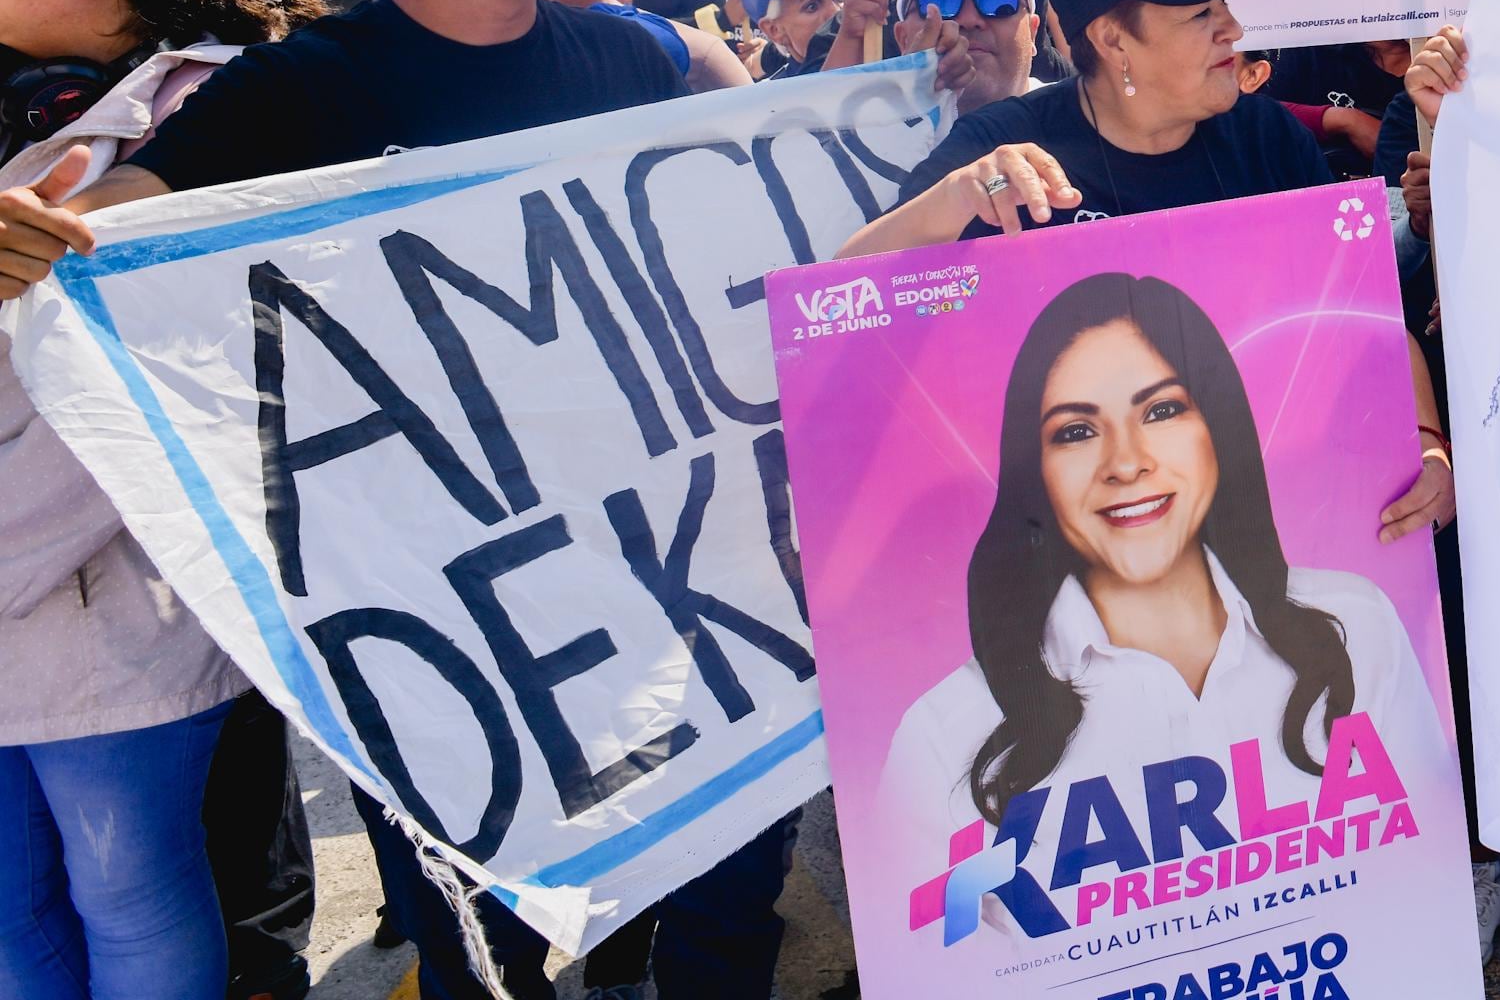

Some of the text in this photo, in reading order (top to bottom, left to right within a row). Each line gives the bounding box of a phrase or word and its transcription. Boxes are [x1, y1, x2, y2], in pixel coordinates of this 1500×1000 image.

[1290, 17, 1346, 29] PROPUESTAS
[1361, 9, 1439, 23] karlaizcalli.com
[795, 276, 884, 323] VOTA
[890, 276, 918, 288] FUERZA
[919, 272, 924, 281] Y
[962, 264, 979, 276] POR
[793, 313, 892, 340] 2 DE JUNIO
[943, 711, 1409, 948] KARLA
[1076, 802, 1420, 928] PRESIDENTA
[995, 869, 1358, 977] CANDIDATA CUAUTITLÁN IZCALLI
